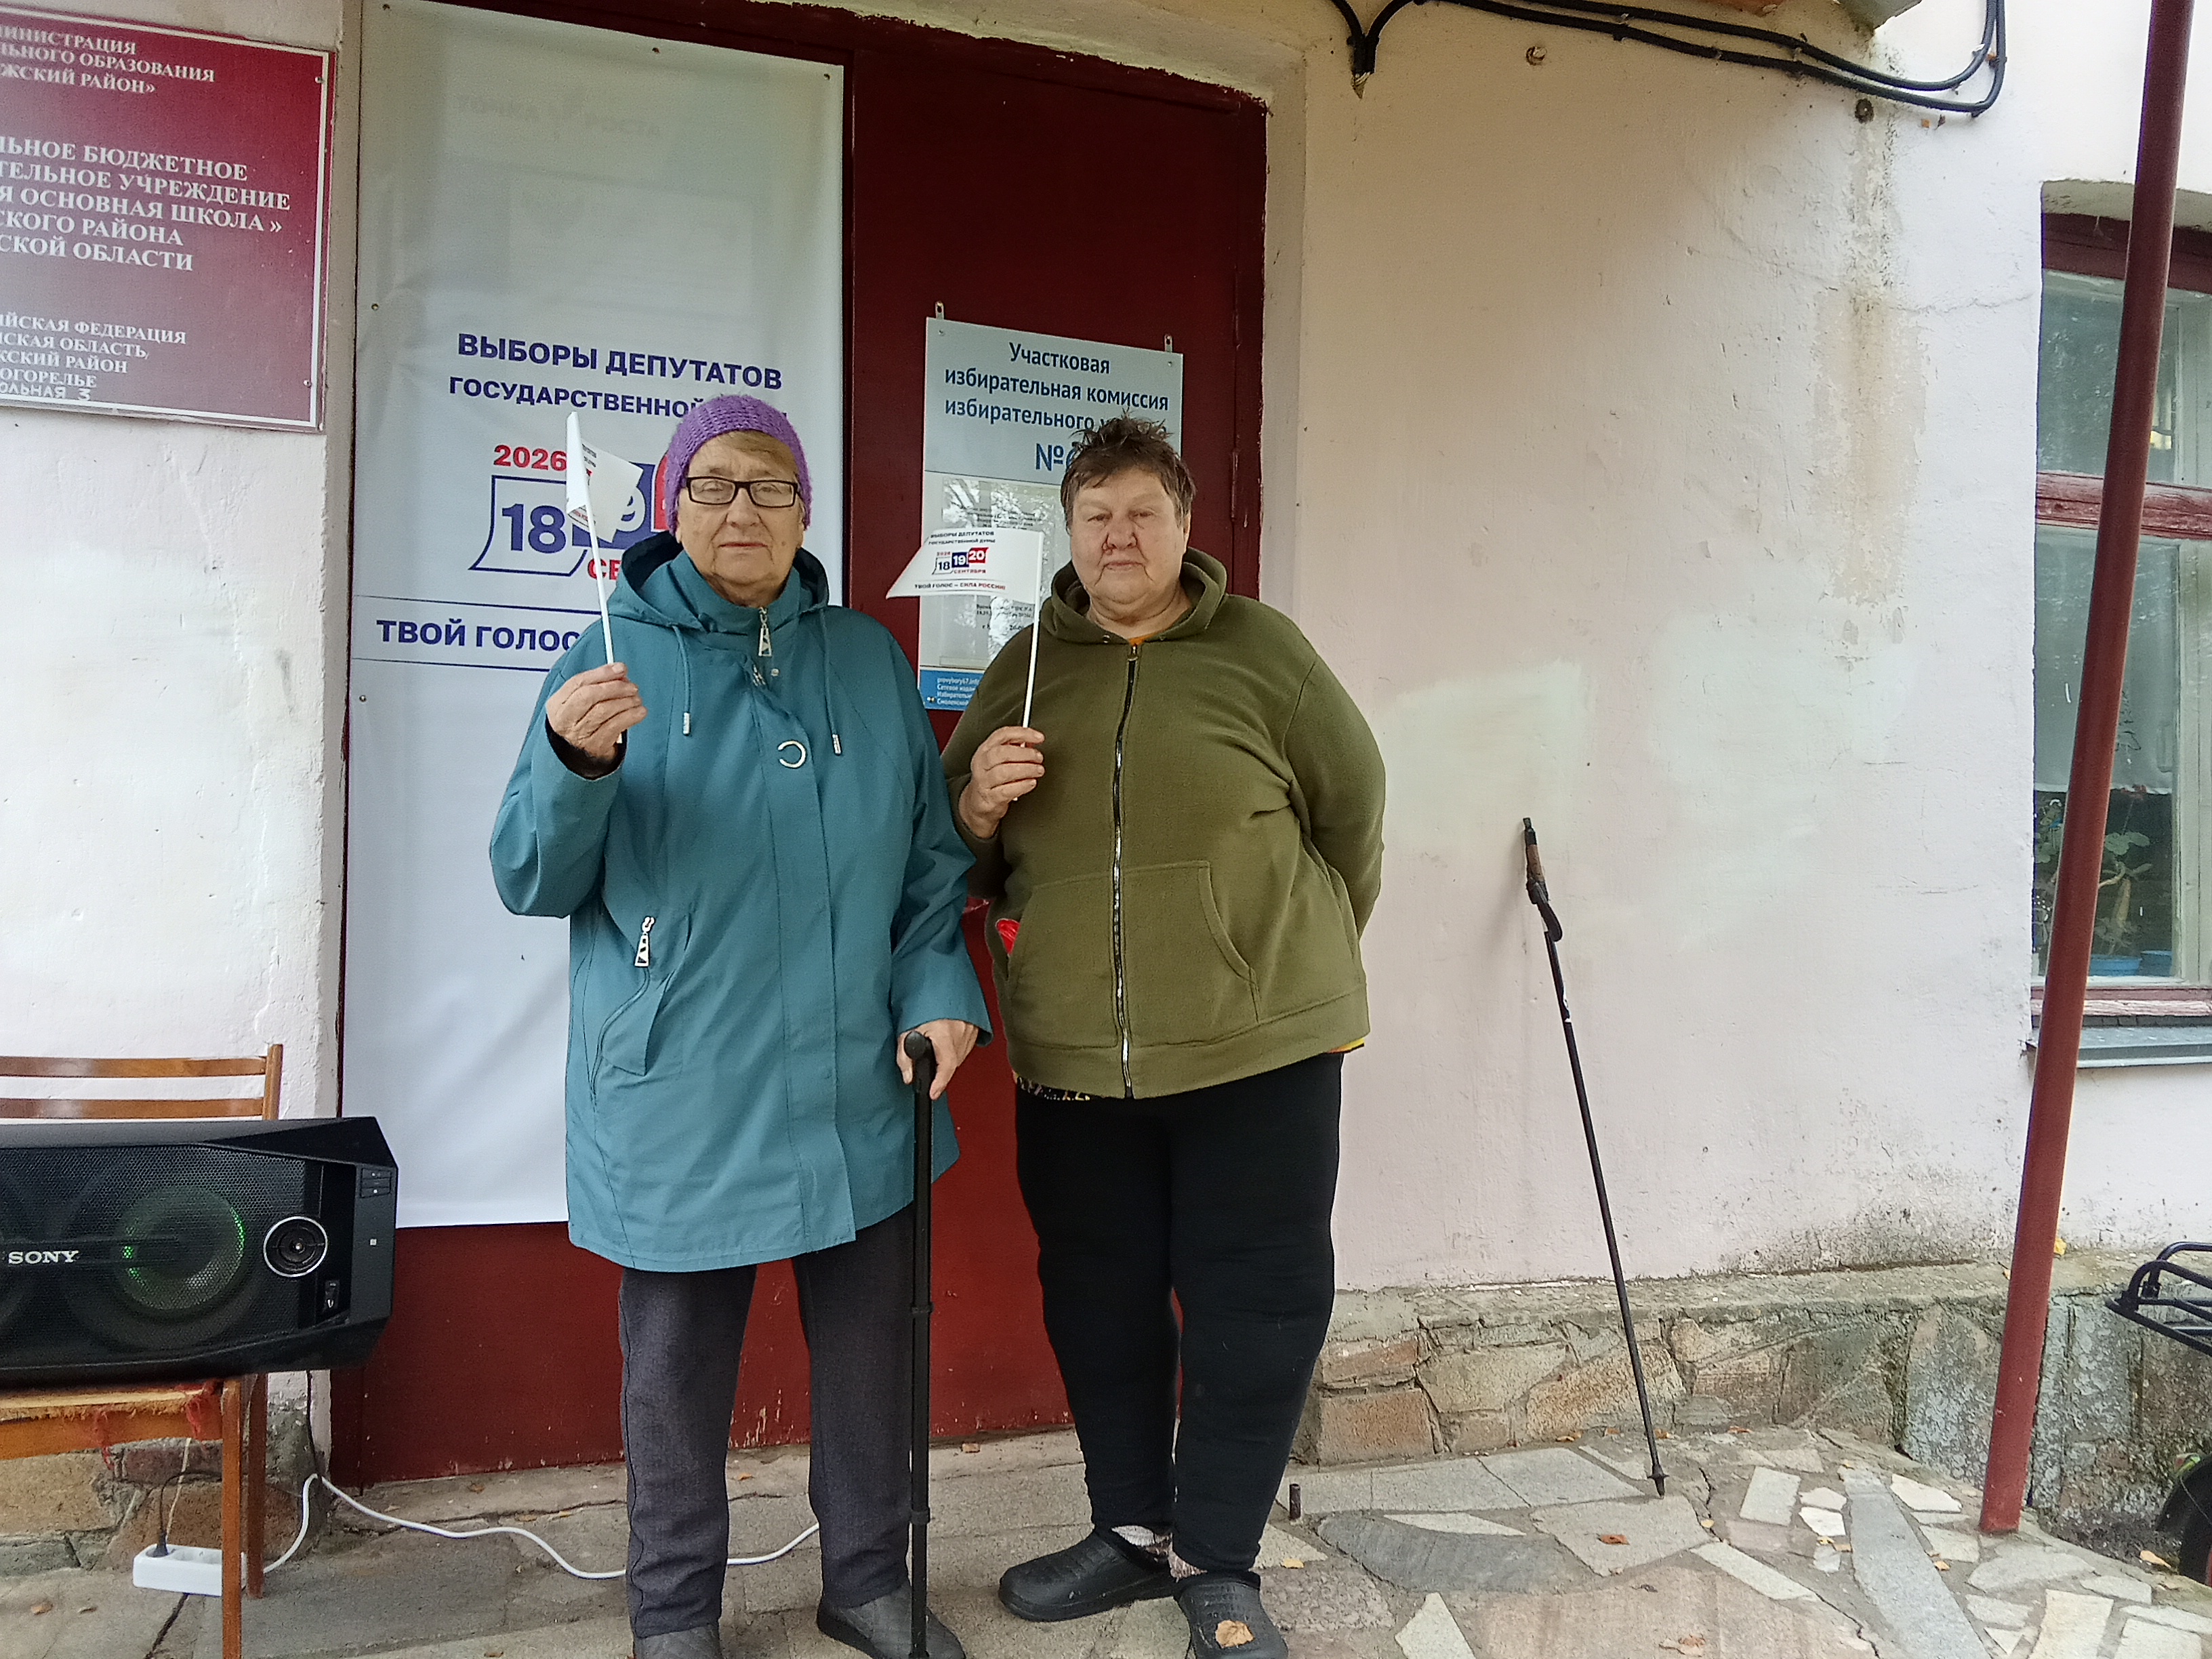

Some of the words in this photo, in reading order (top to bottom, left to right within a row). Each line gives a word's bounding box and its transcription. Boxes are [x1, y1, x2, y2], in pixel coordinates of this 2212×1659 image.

[0, 24, 136, 55] ИНИСТРАЦИЯ
[79, 53, 216, 83] ОБРАЗОВАНИЯ
[81, 73, 156, 94] РАЙОН»
[82, 144, 248, 182] БЮДЖЕТНОЕ
[20, 188, 163, 220] ОСНОВНАЯ
[118, 173, 291, 211] УЧРЕЖДЕНИЕ
[82, 218, 184, 247] РАЙОНА
[73, 242, 193, 271] ОБЛАСТИ
[0, 332, 55, 350] СКАЯ
[74, 321, 186, 344] ФЕДЕРАЦИЯ
[66, 354, 127, 373] РАЙОН
[457, 333, 598, 370] ВЫБОРЫ
[605, 350, 782, 390] ДЕПУТАТОВ
[1008, 342, 1110, 374] Участковая
[0, 368, 97, 388] ОГОРЕЛЬЕ
[945, 367, 1082, 401] избирательная
[1087, 387, 1168, 411] комиссия
[945, 398, 1094, 430] избирательного
[493, 445, 567, 471] 2026
[501, 503, 567, 554] 18
[938, 561, 951, 571] 18
[952, 554, 966, 566] 19
[968, 550, 985, 561] 20
[376, 618, 466, 647] ТВОЙ
[8, 1250, 79, 1265] SONY
